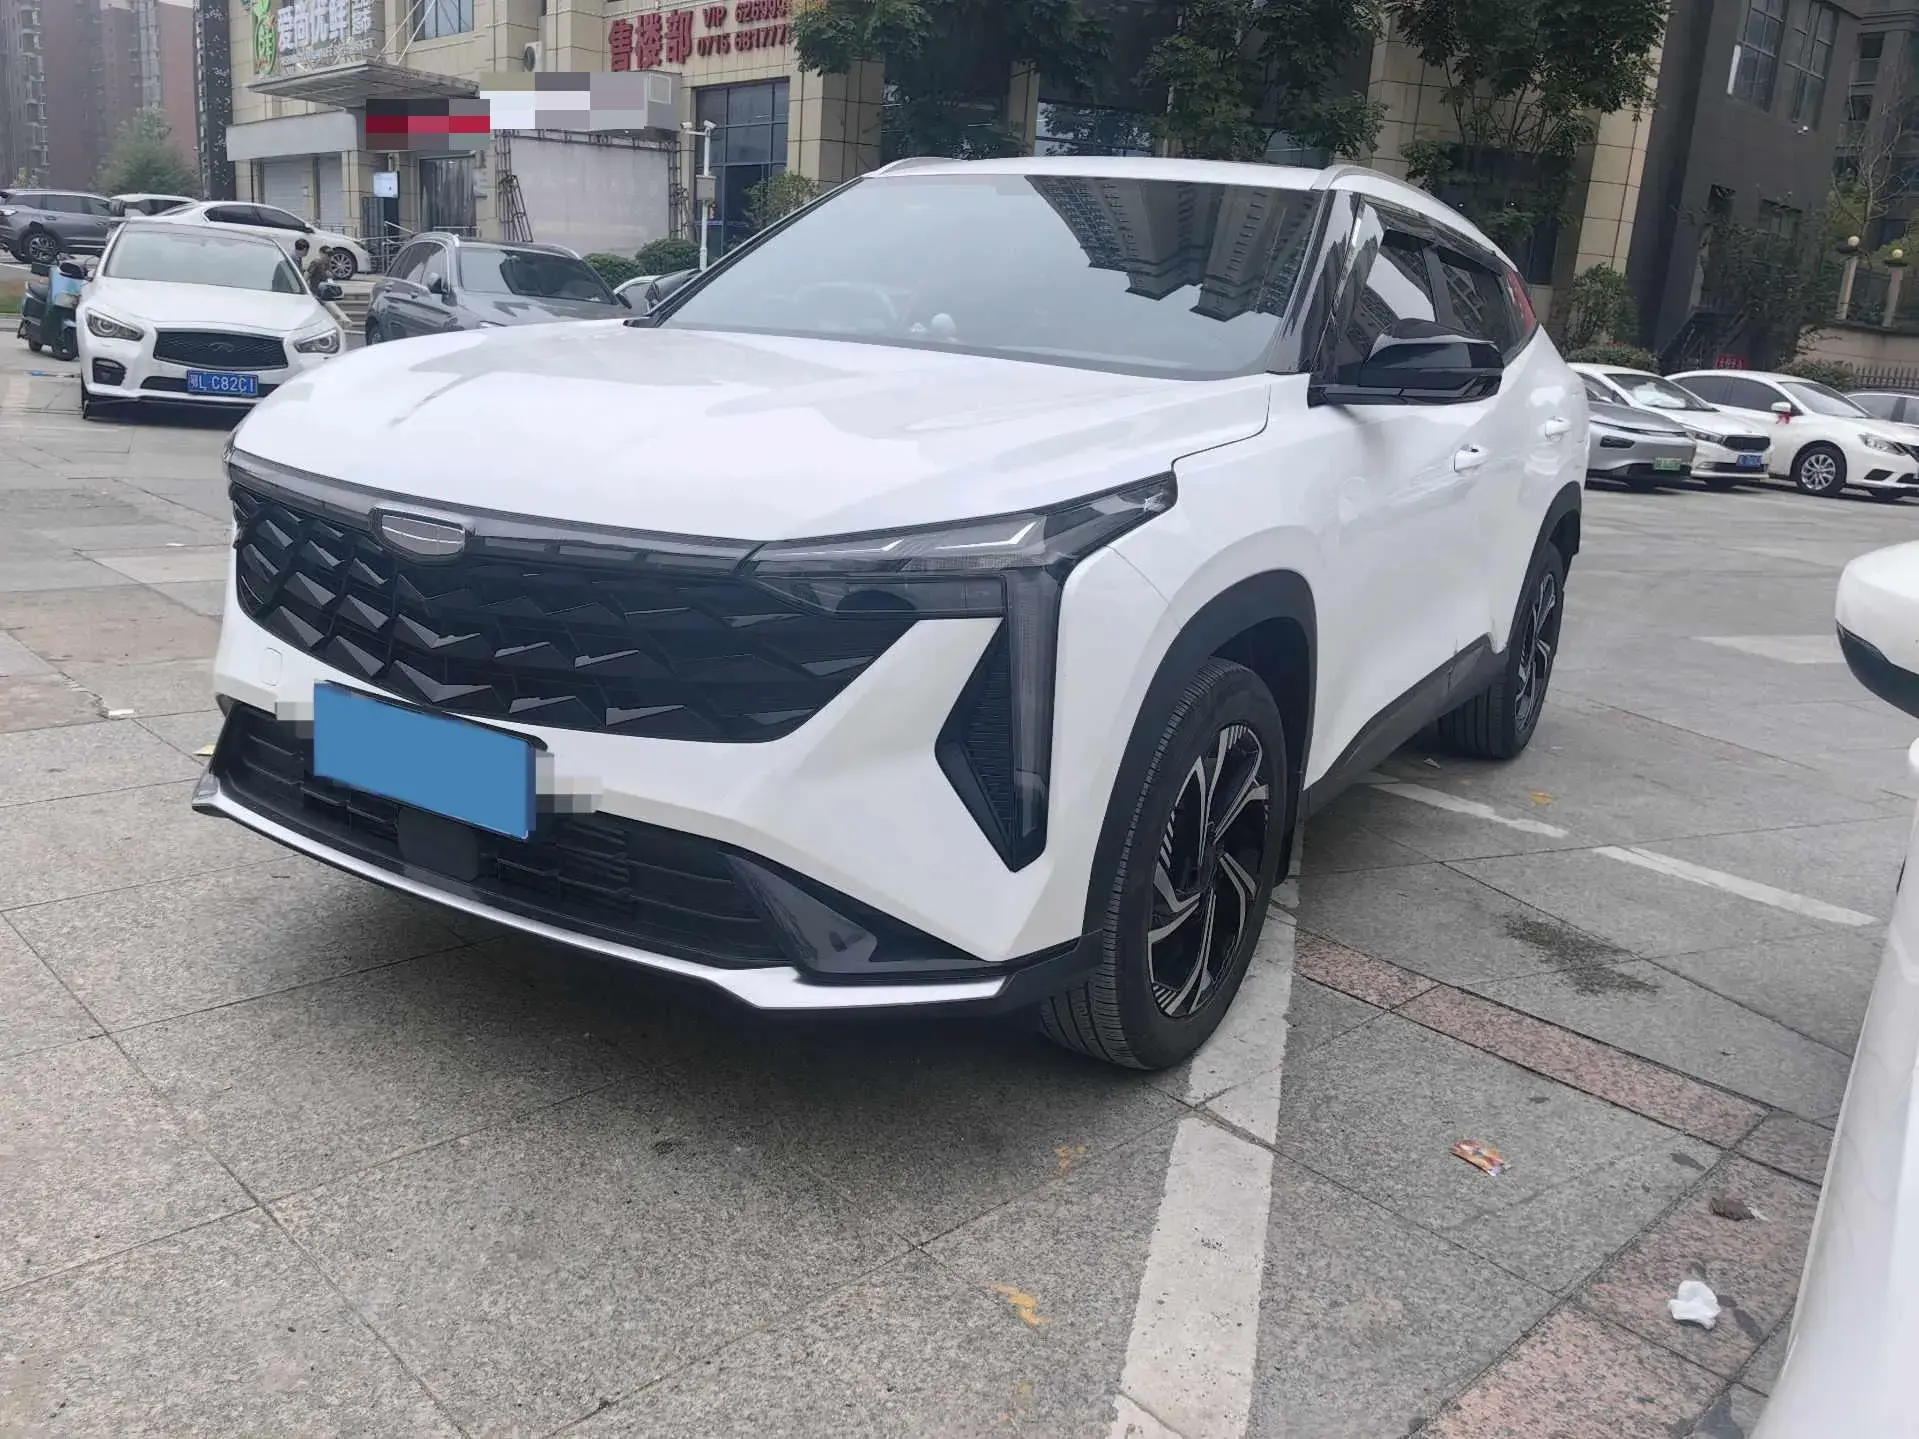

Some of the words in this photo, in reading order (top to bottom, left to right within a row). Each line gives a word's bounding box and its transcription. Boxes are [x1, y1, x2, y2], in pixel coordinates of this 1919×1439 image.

[703, 6, 727, 29] VIP
[609, 9, 693, 72] 售楼部
[697, 33, 731, 57] 0715
[735, 24, 796, 51] 681777
